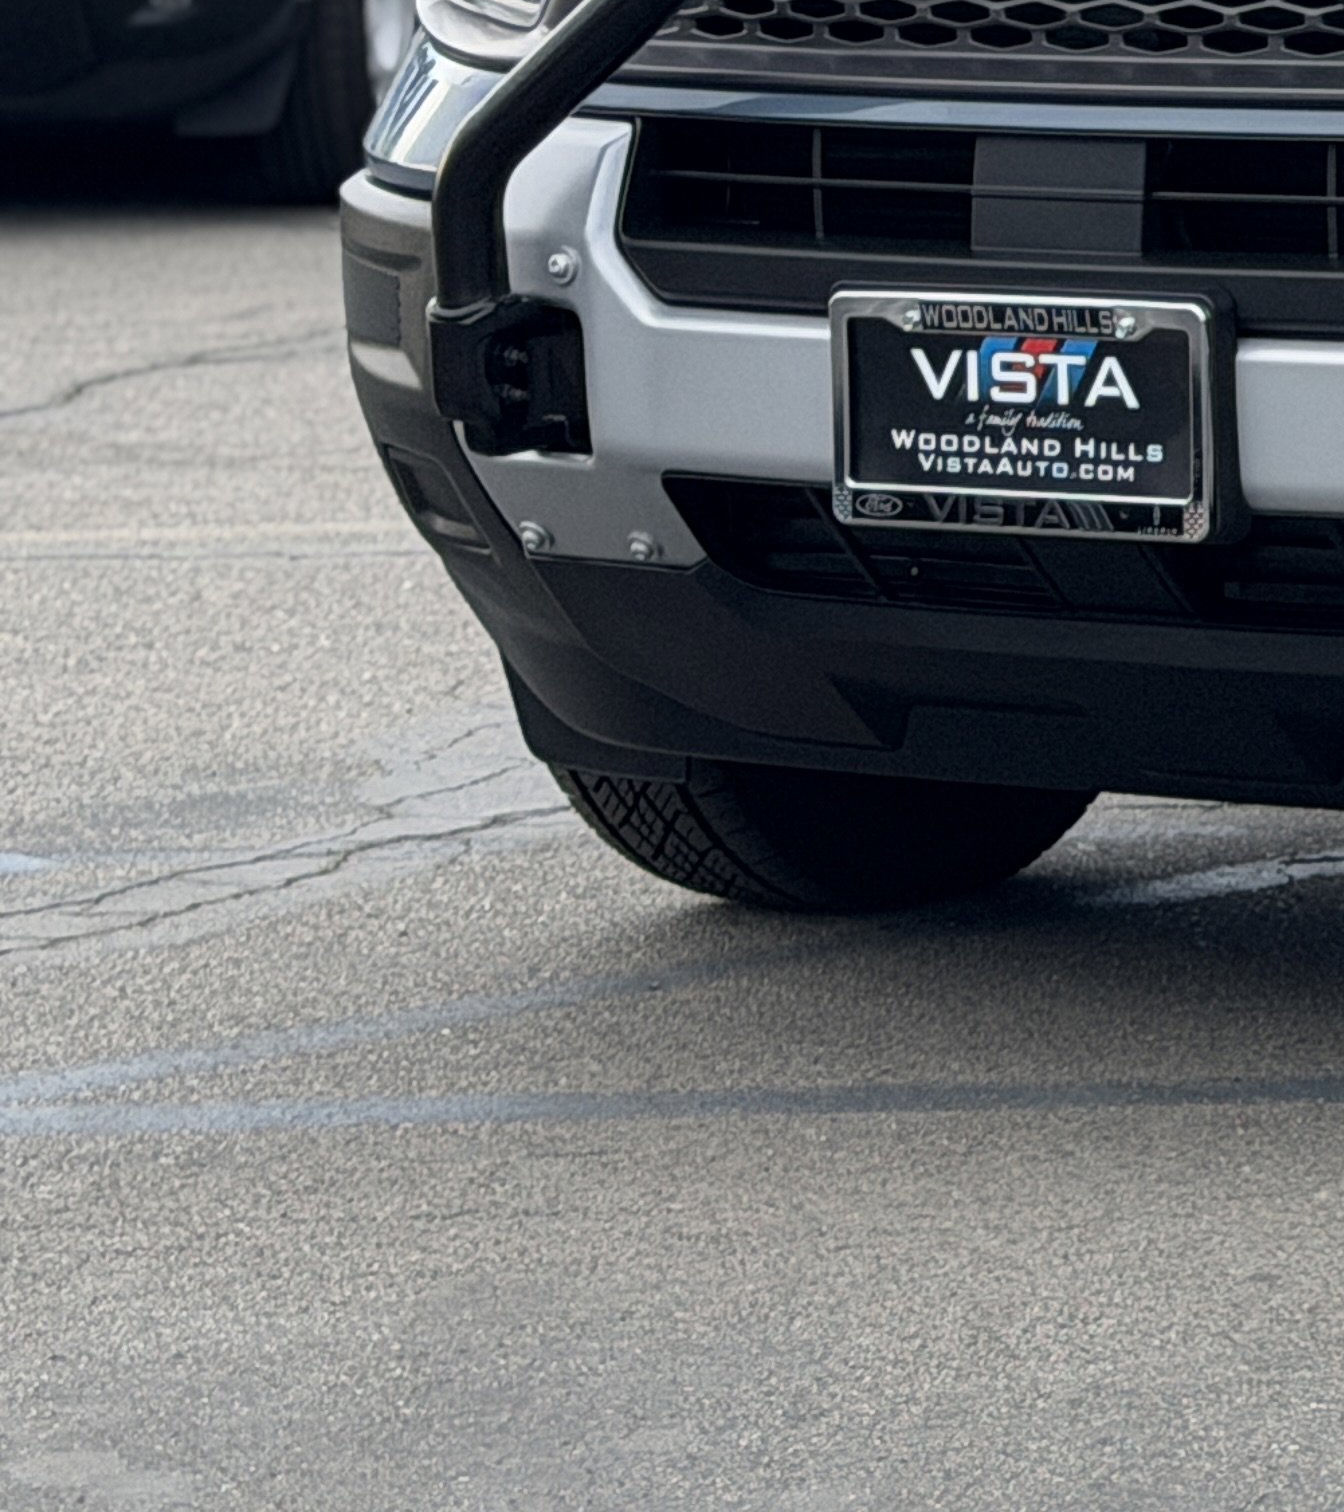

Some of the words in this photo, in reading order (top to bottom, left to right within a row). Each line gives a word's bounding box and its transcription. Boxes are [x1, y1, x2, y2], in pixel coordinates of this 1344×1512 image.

[921, 303, 1055, 331] WOODLAND
[1052, 308, 1114, 334] HILLS
[909, 347, 1141, 410] VISTA
[890, 428, 1062, 457] WOODLAND
[1074, 437, 1165, 463] HILLS
[923, 492, 1071, 530] VISTA
